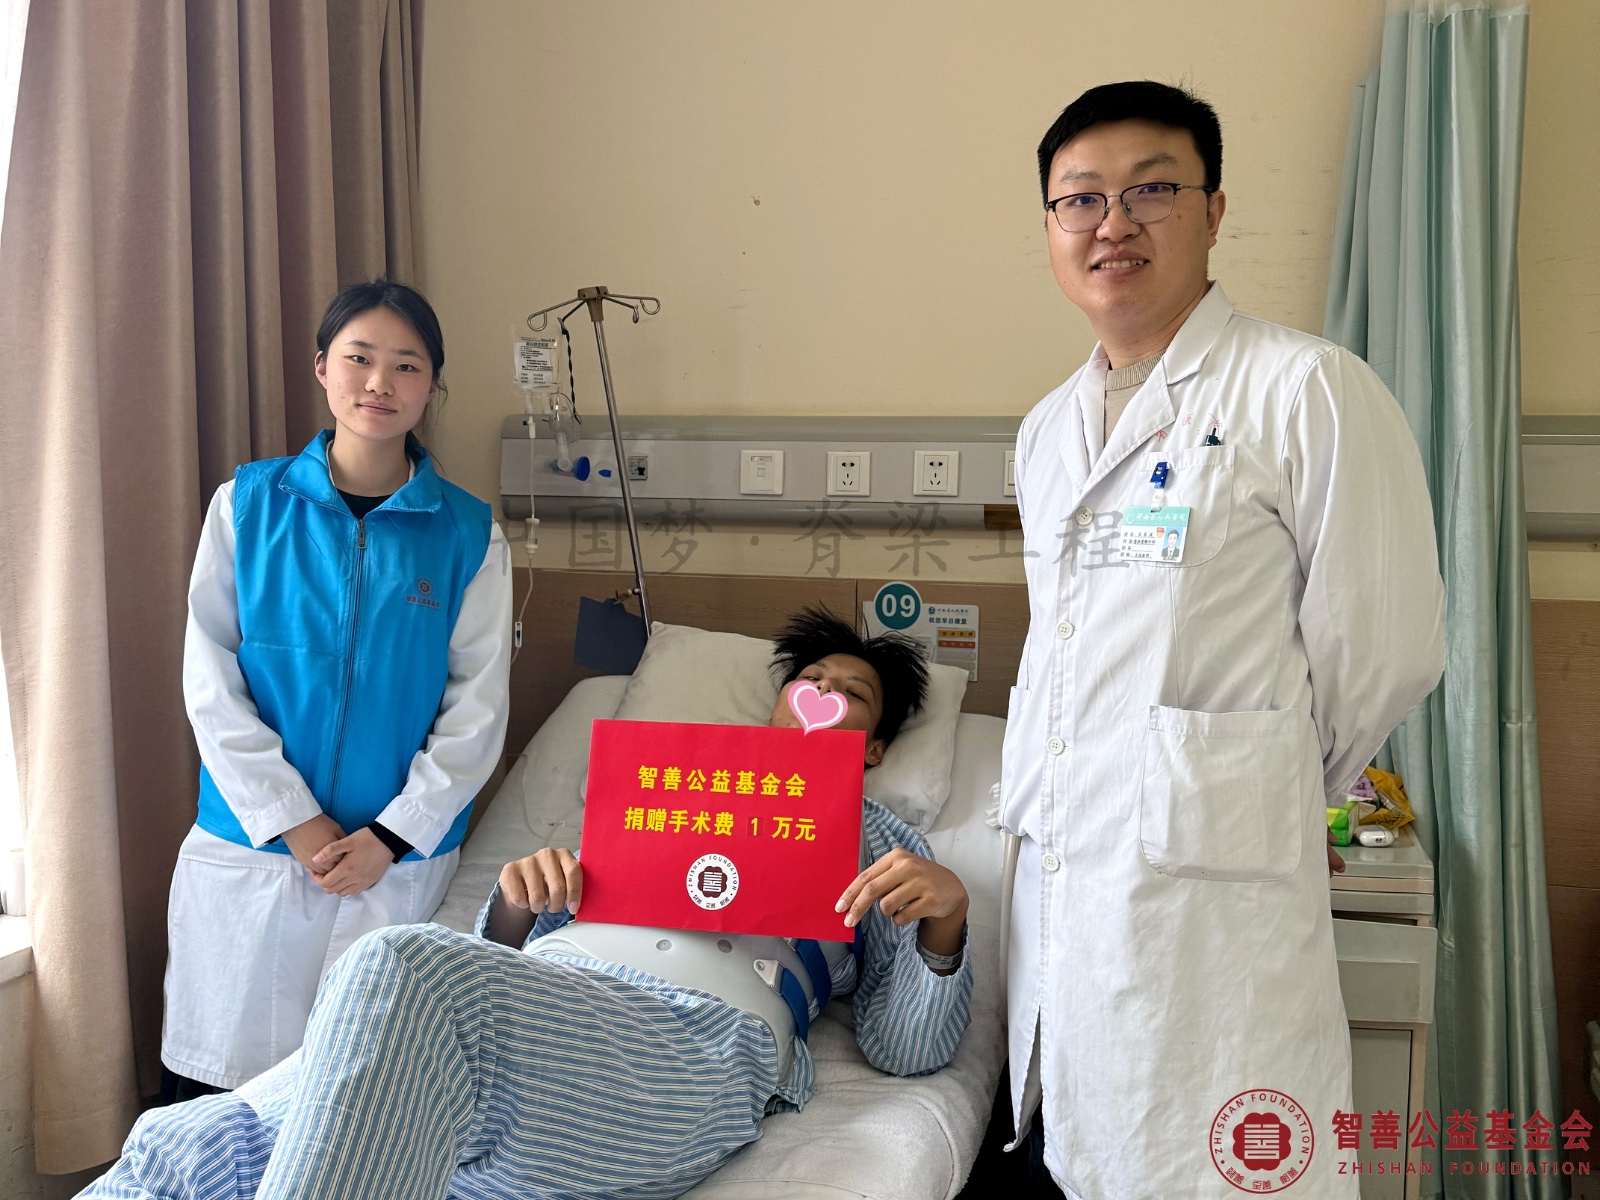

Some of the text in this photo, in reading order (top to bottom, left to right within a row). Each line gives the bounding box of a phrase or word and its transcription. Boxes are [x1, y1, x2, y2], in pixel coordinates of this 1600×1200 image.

[881, 593, 916, 618] 09
[638, 765, 806, 797] 智善公益基金会
[624, 806, 817, 841] 捐赠手术费 1 万元
